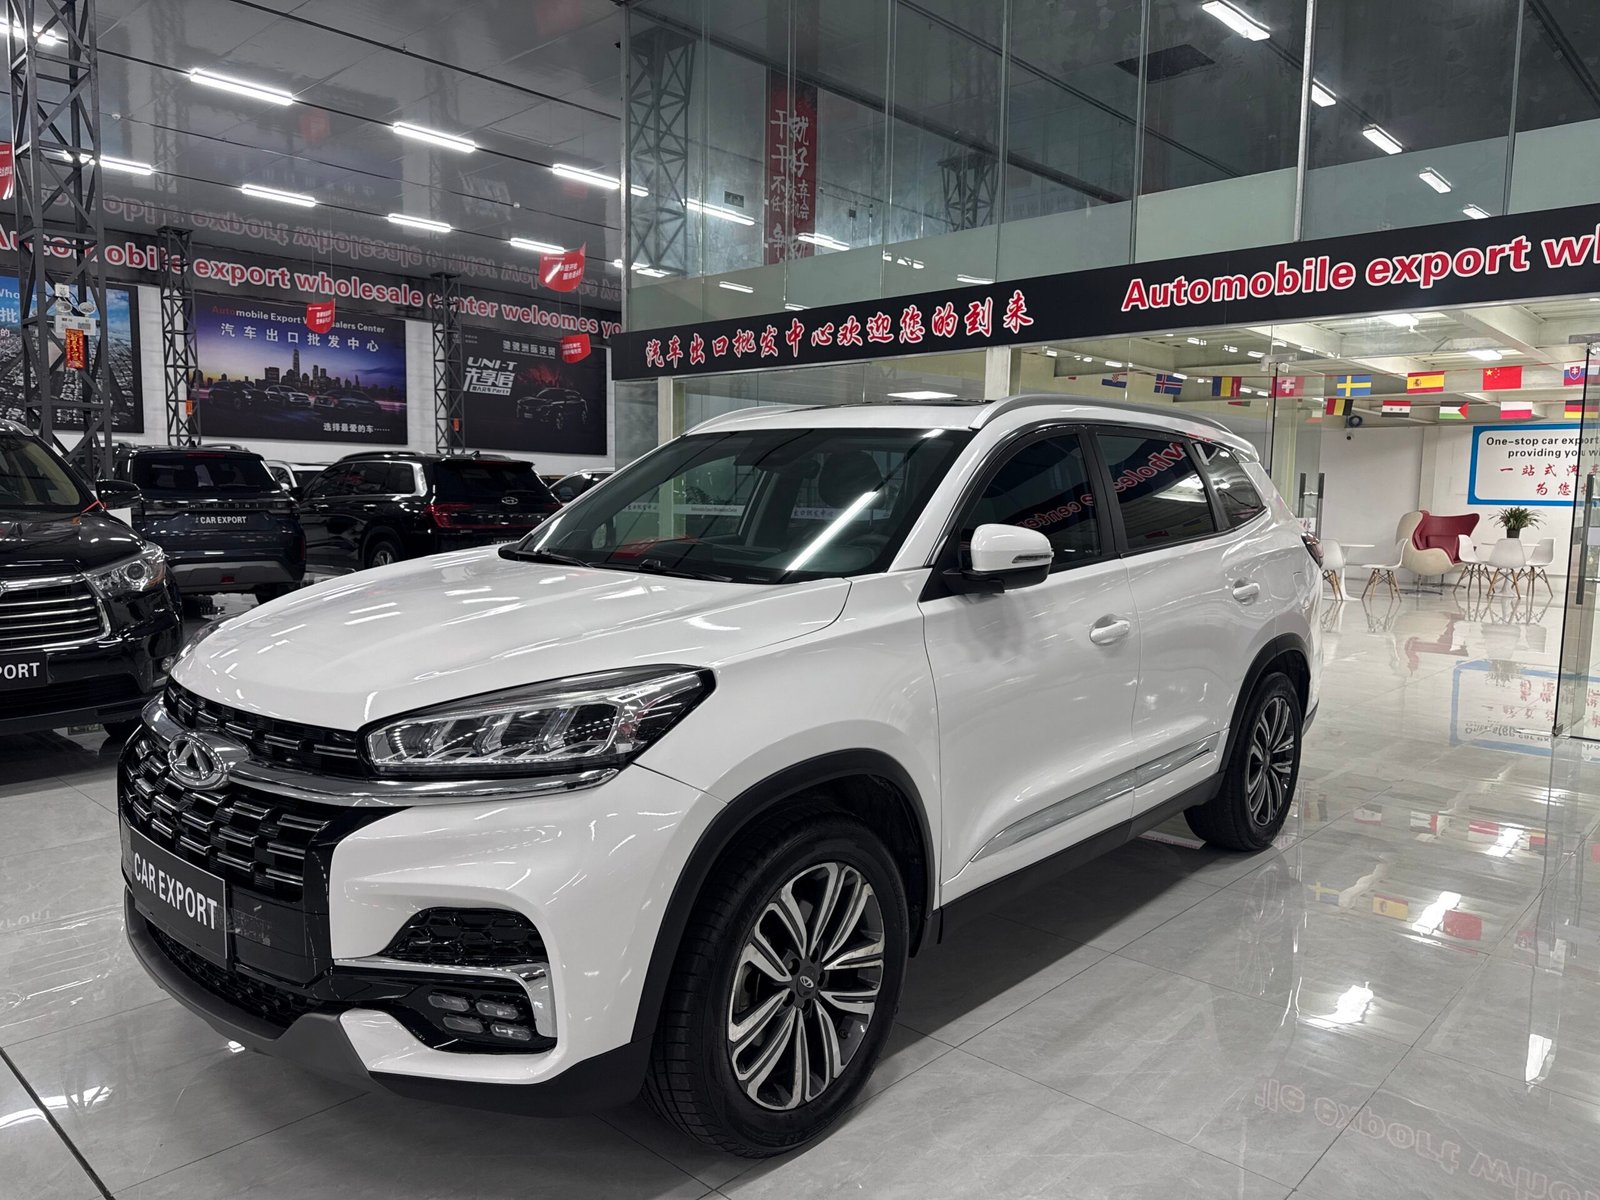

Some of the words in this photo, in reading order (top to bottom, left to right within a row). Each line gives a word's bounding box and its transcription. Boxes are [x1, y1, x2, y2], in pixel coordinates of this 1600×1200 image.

[1120, 256, 1356, 311] Automobile
[1365, 235, 1532, 289] export
[193, 258, 291, 286] export
[295, 271, 423, 307] wholesale
[502, 303, 598, 334] welcomes
[270, 313, 301, 325] Export
[356, 323, 386, 334] Center
[221, 322, 379, 352] 汽车出口批发中心
[467, 356, 518, 371] UNI-T
[1486, 436, 1539, 446] One-stop
[1508, 448, 1561, 458] providing
[200, 516, 216, 524] CAR
[217, 515, 247, 524] EXPORT
[134, 852, 156, 894] CAR
[158, 869, 218, 930] EXPORT
